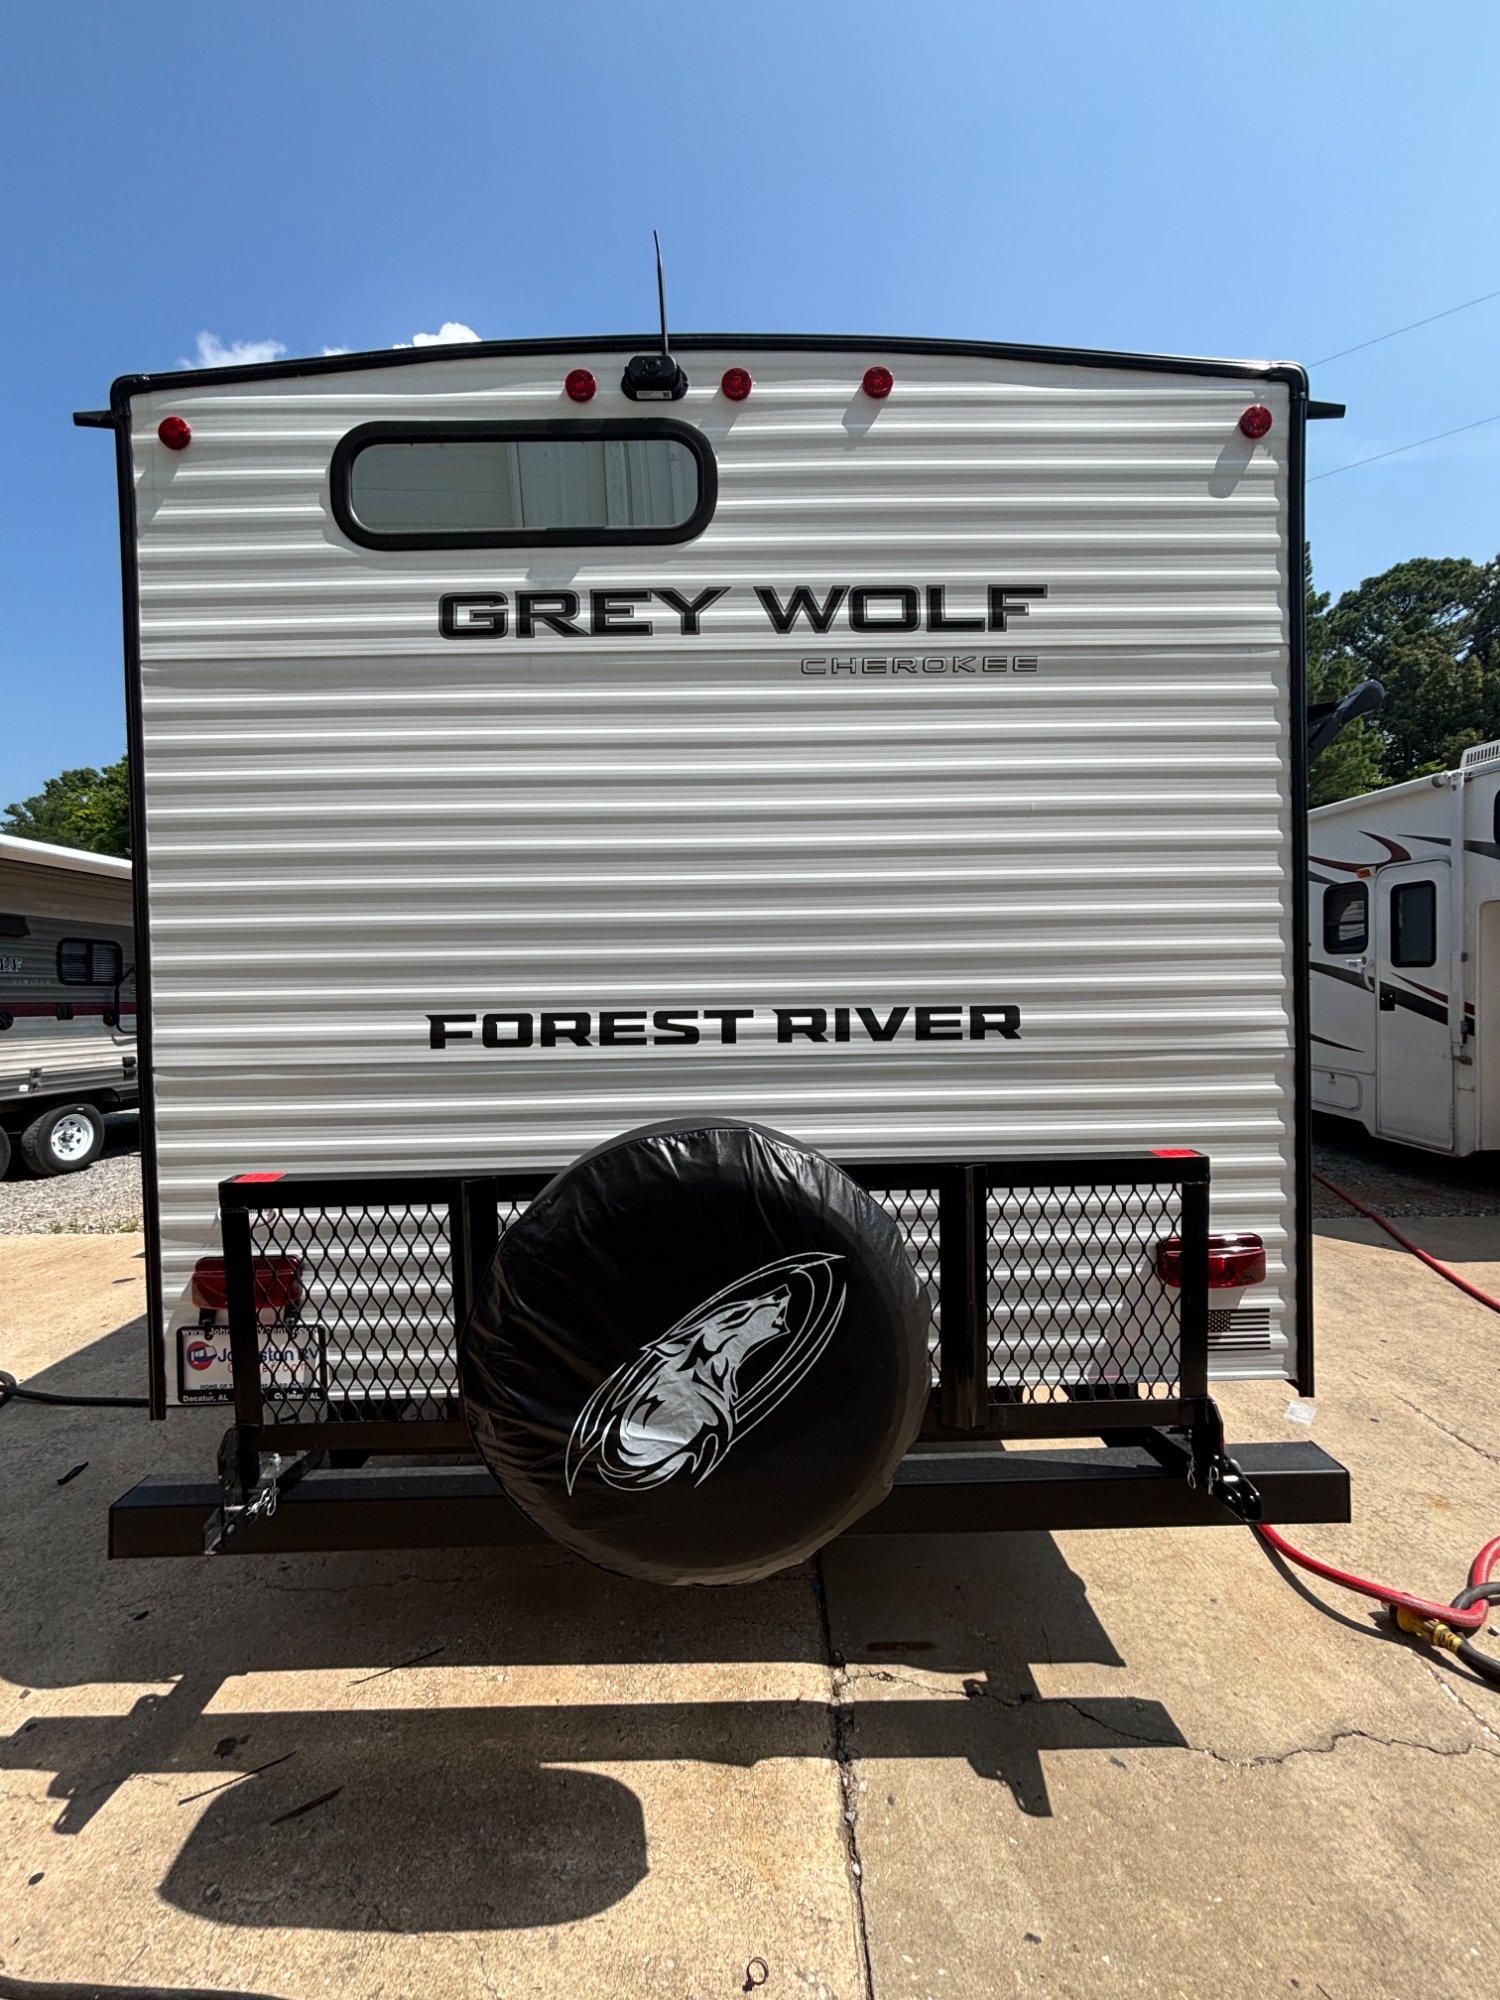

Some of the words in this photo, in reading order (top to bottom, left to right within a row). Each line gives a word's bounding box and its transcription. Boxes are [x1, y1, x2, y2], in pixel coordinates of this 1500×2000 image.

[438, 586, 732, 640] GREY
[752, 583, 1049, 635] WOLF
[800, 655, 1039, 675] CHEROKEE
[425, 1009, 755, 1049] FOREST
[771, 1004, 1023, 1043] RIVER
